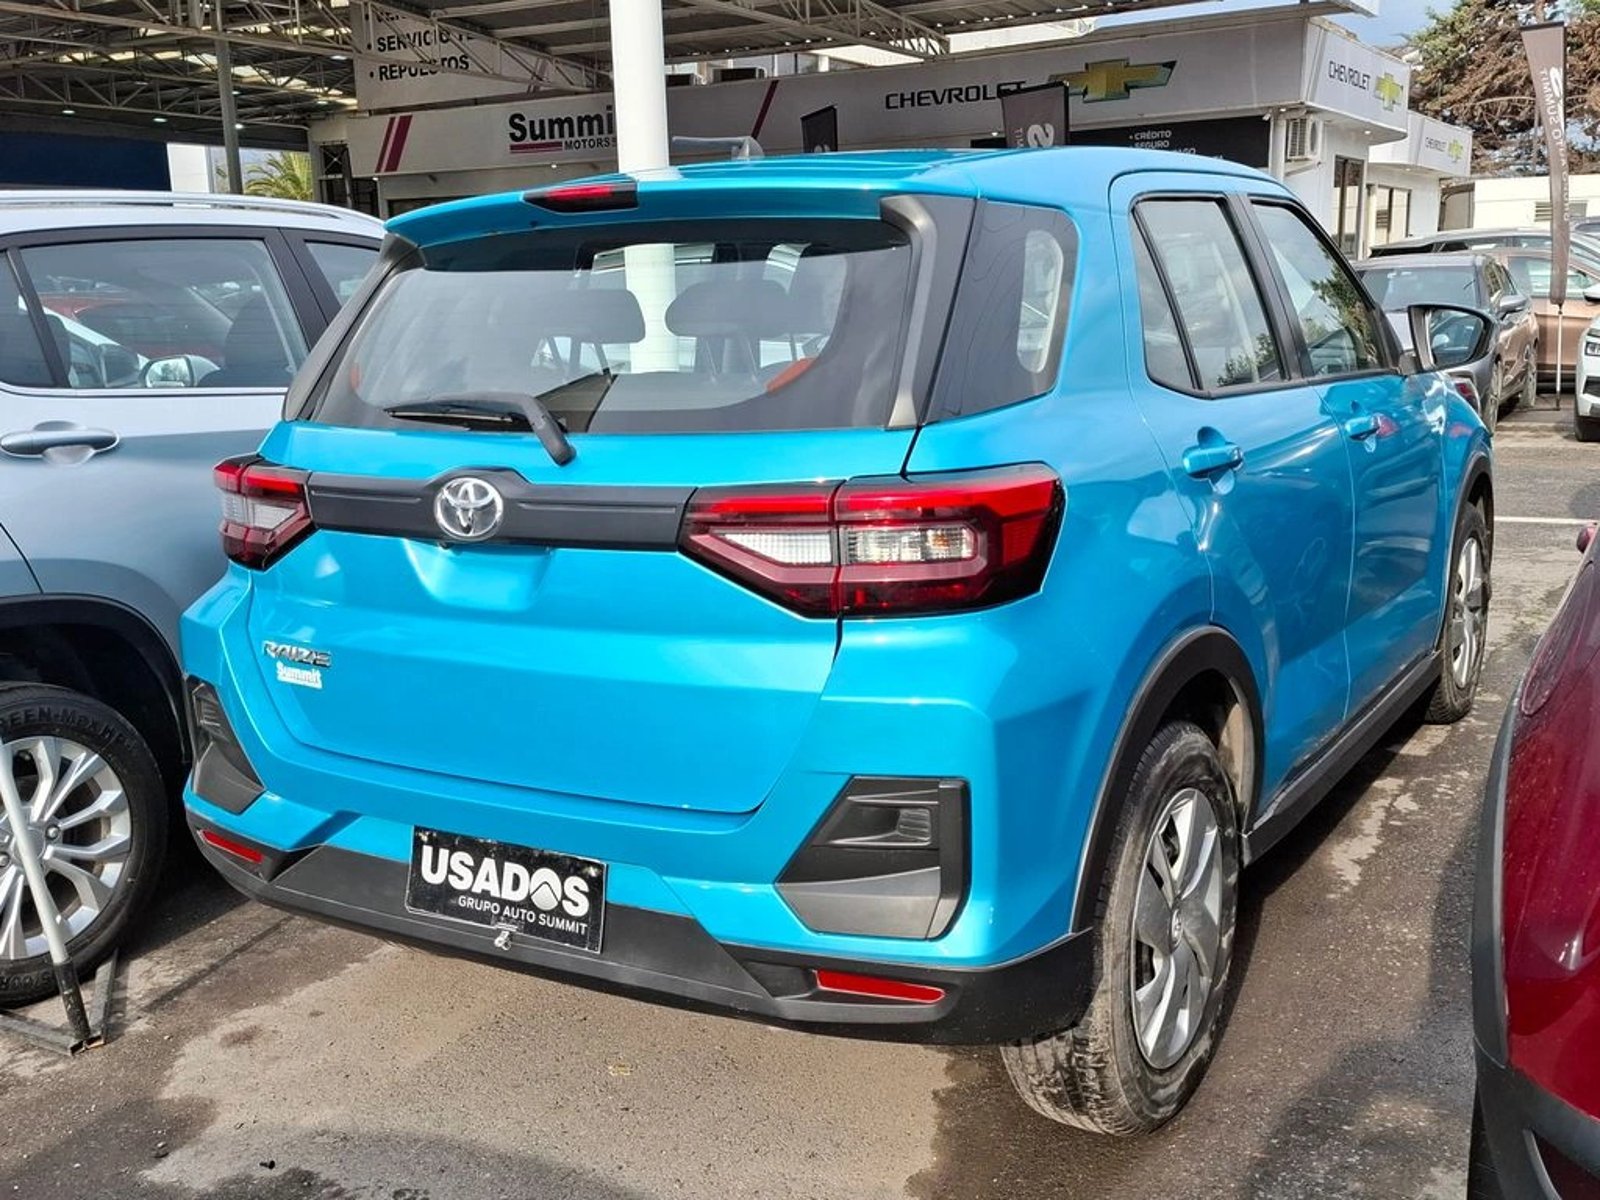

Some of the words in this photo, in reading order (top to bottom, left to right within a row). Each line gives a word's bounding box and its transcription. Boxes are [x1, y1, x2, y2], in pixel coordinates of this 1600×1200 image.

[1329, 61, 1370, 91] CHEVROLET
[508, 104, 613, 142] Summi
[564, 137, 610, 150] MOTORS
[421, 845, 590, 917] USADOS
[458, 896, 500, 915] GRUPO
[503, 906, 536, 923] AUTO
[538, 913, 588, 936] SUMMIT
